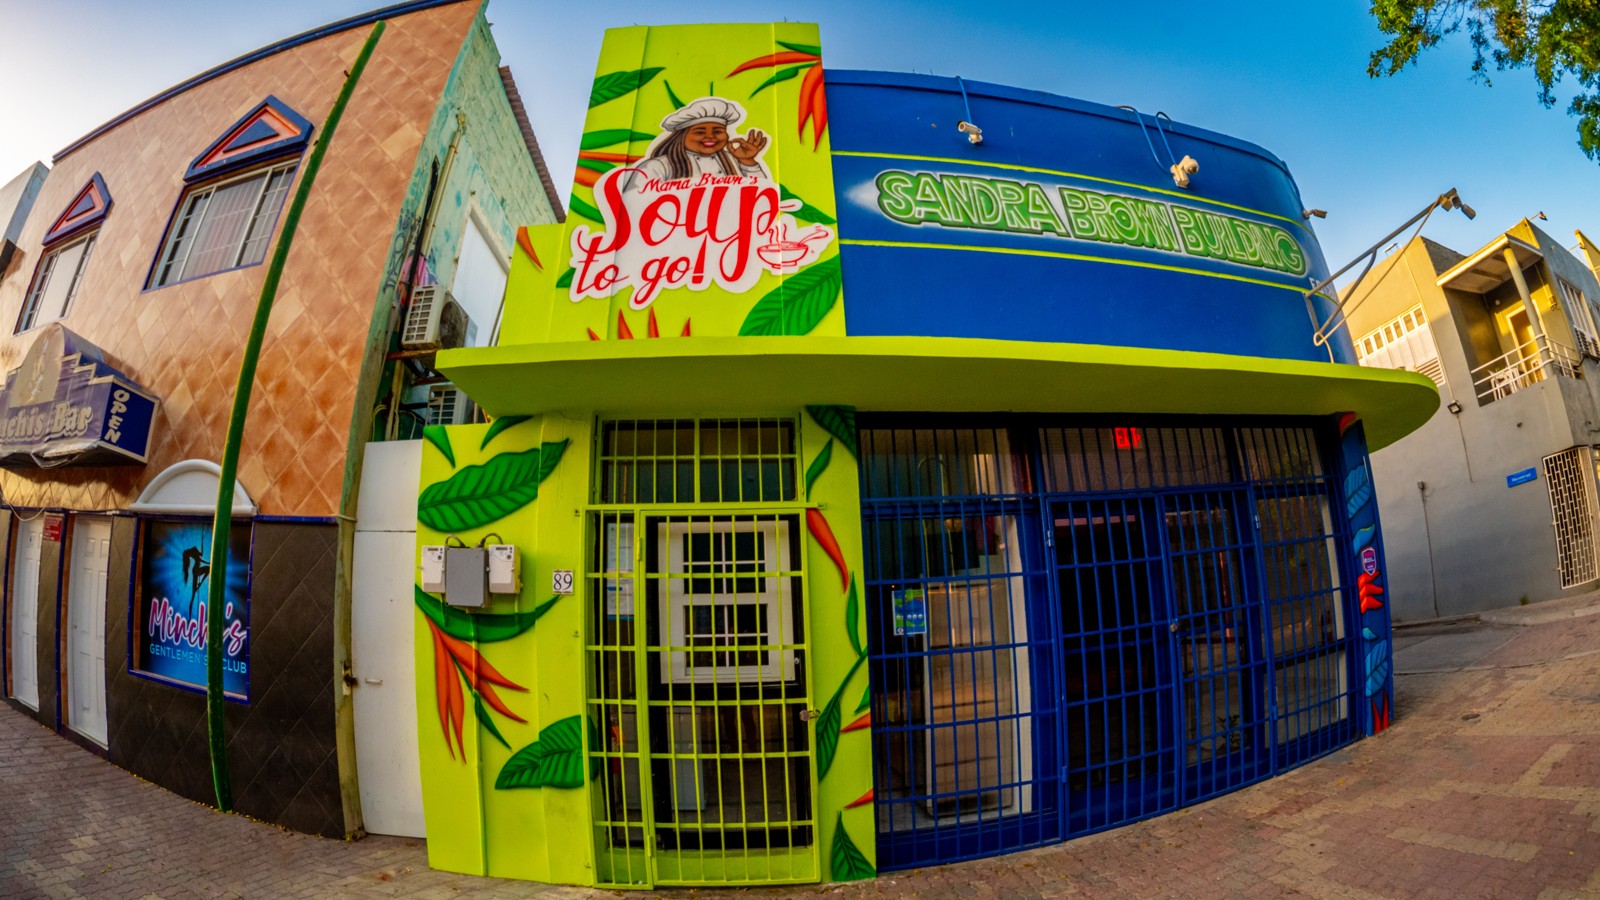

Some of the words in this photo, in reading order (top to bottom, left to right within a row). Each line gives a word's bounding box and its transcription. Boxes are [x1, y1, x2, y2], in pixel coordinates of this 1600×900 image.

[638, 179, 692, 194] Mama
[695, 172, 759, 188] Brown's
[577, 168, 782, 283] Soup
[877, 172, 1070, 236] SANDRA
[1060, 188, 1181, 252] BROWN
[1172, 205, 1305, 275] BUILDING
[576, 236, 630, 295] to
[633, 235, 708, 305] go!
[50, 402, 93, 437] Bar
[104, 389, 130, 443] OPEN
[553, 573, 573, 591] 89
[149, 598, 248, 656] Minch's
